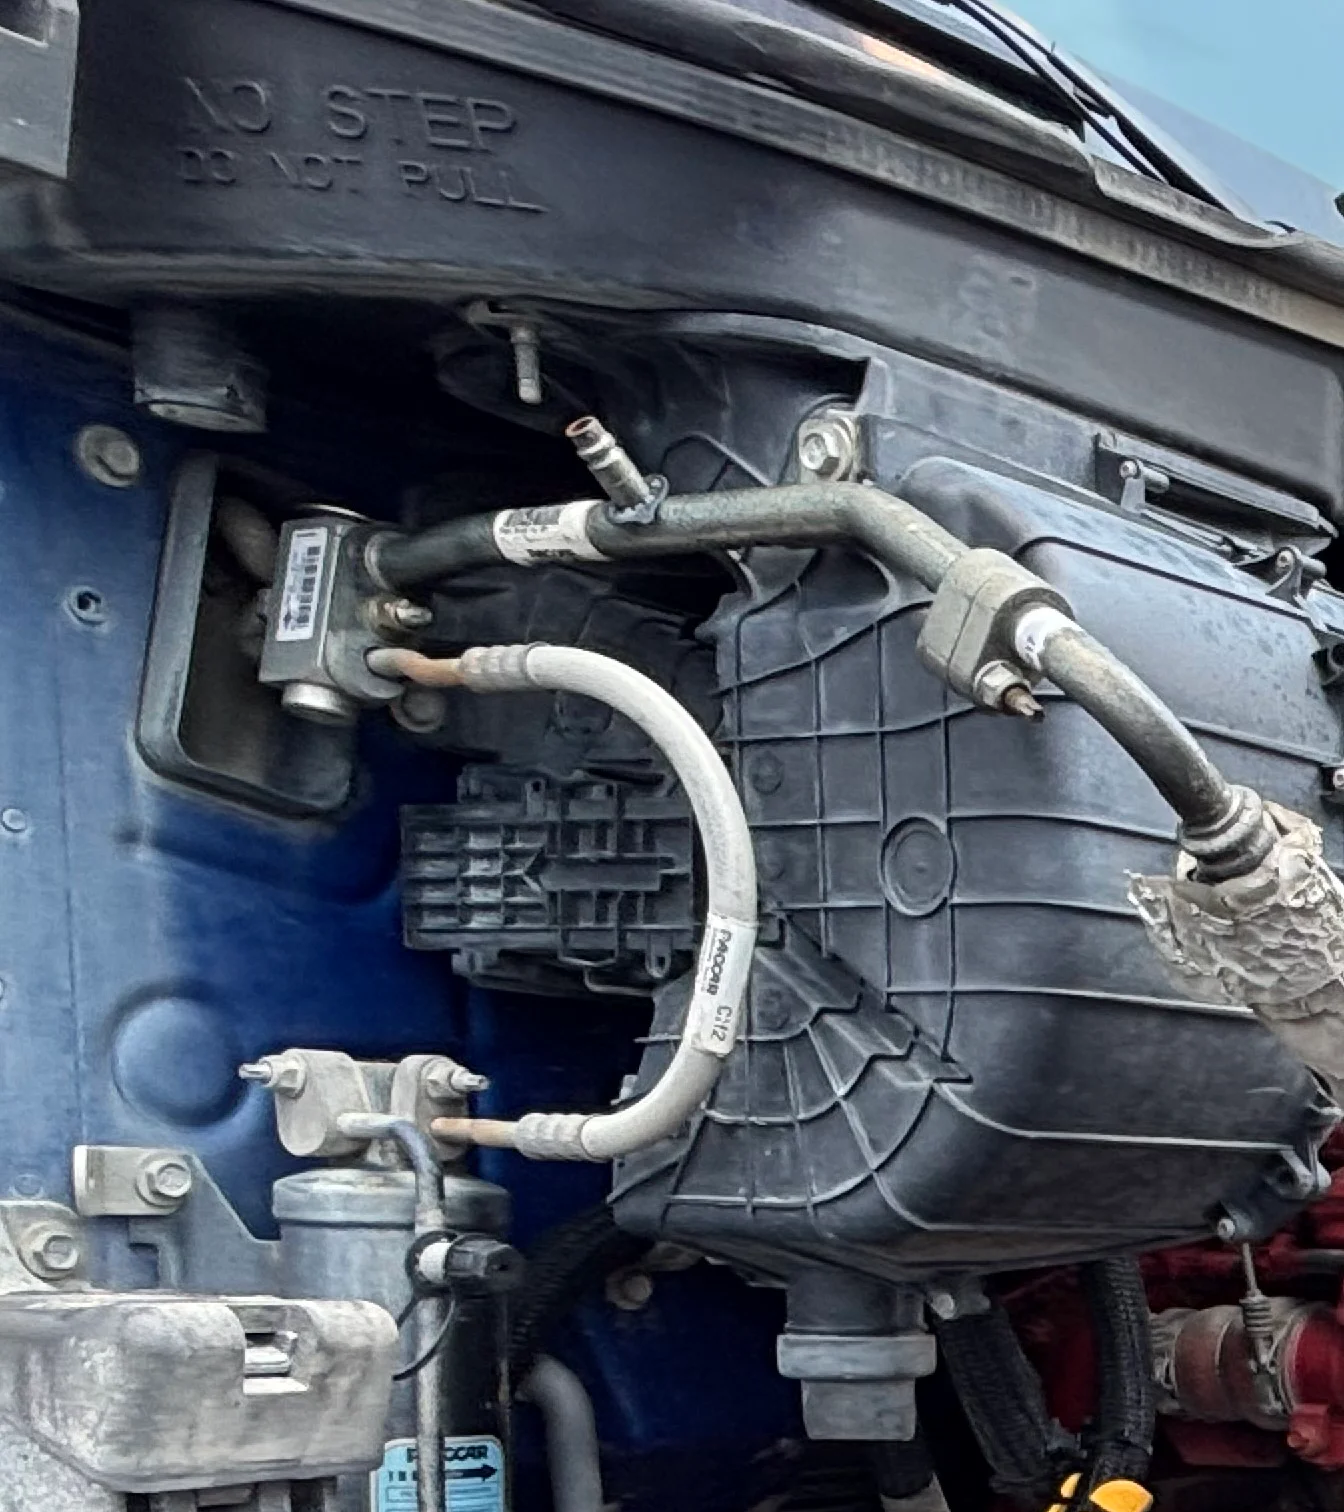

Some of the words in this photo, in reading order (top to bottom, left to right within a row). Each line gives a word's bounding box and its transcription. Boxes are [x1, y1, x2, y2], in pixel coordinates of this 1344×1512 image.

[322, 84, 518, 153] STEP
[397, 159, 550, 213] PULL
[407, 1446, 488, 1463] PCCAR
